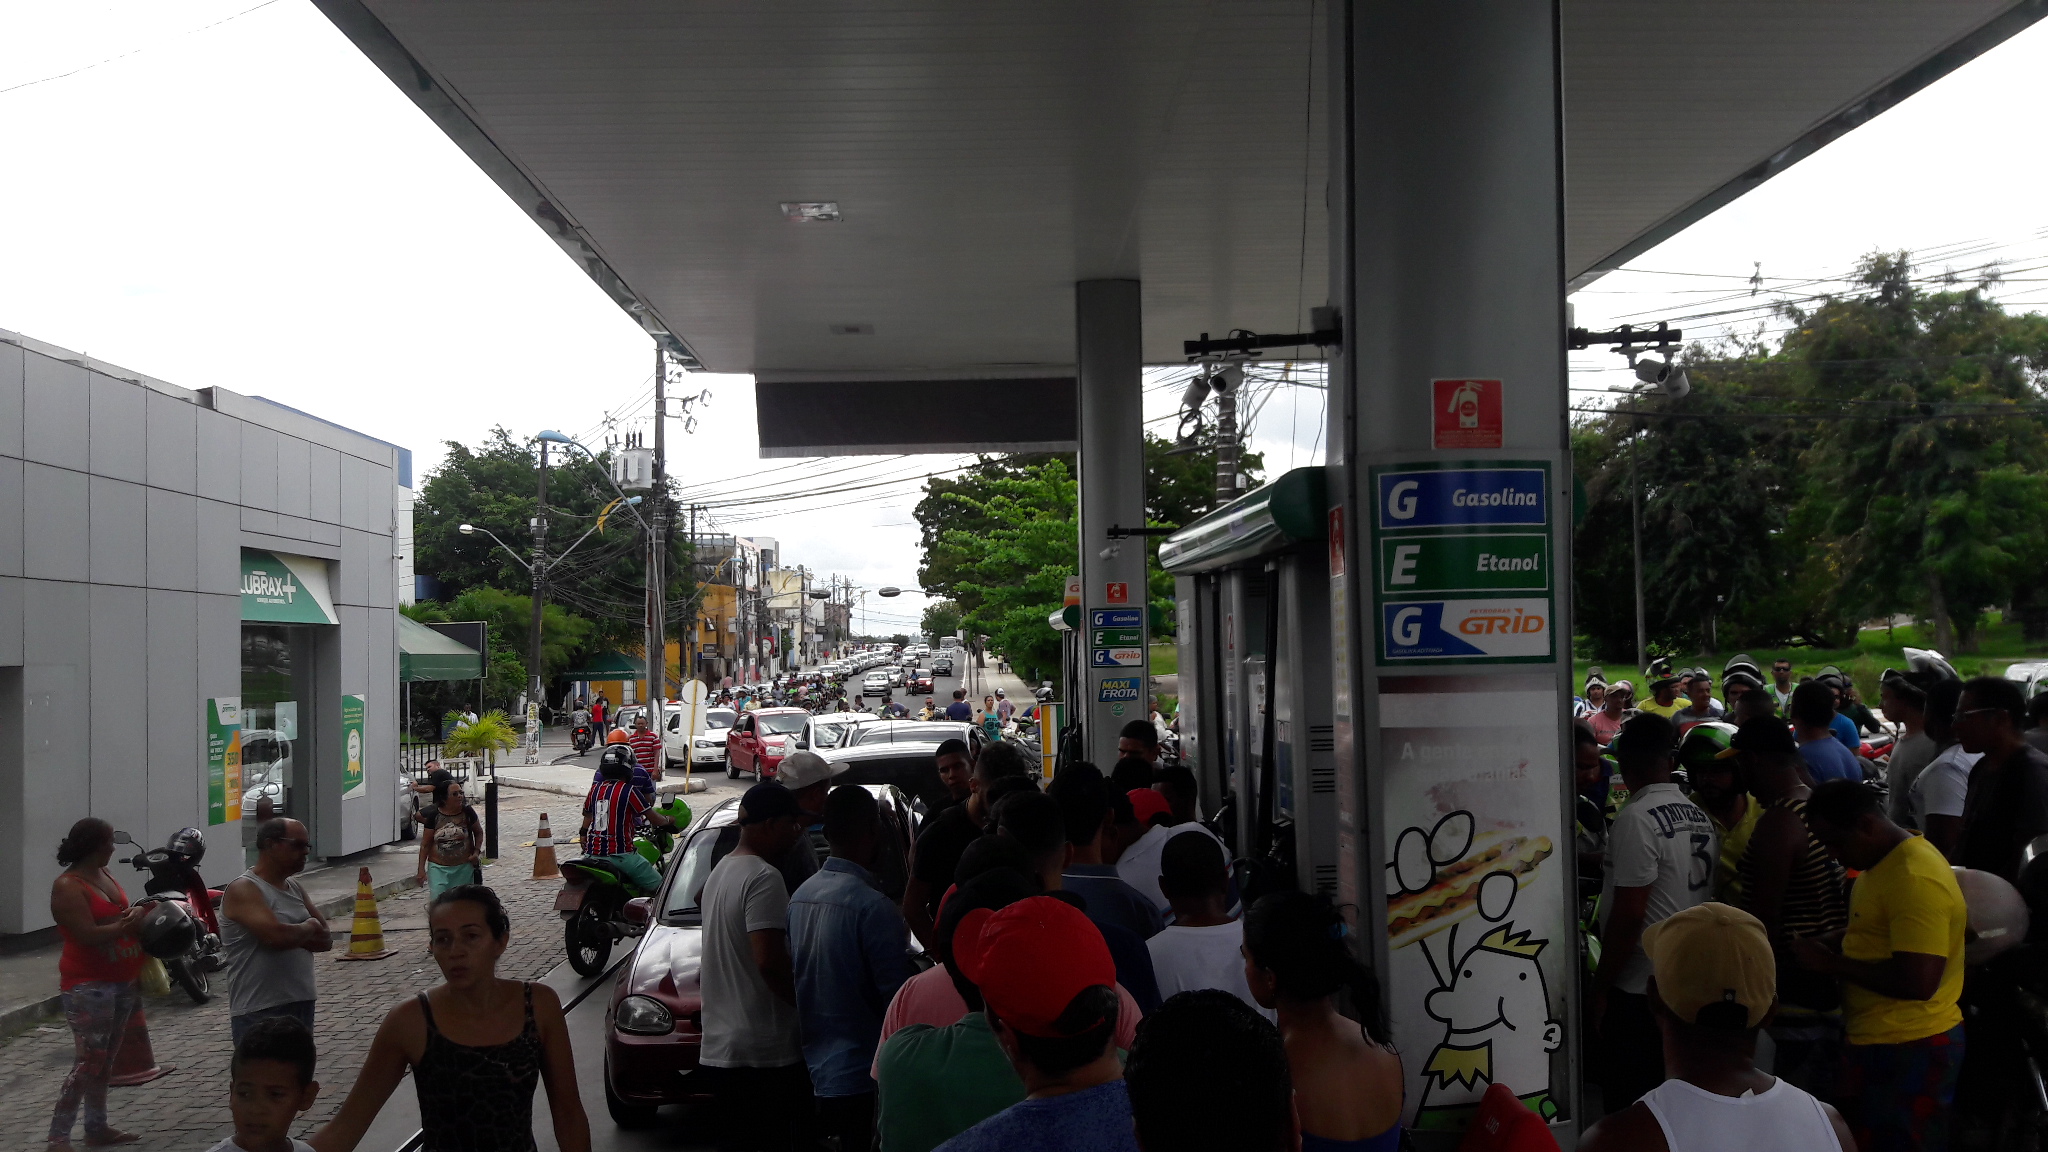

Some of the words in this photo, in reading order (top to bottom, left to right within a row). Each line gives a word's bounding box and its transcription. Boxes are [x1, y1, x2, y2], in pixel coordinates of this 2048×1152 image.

[1388, 480, 1419, 520] G
[1452, 487, 1538, 507] Gasolina
[1390, 544, 1421, 585] E
[1477, 552, 1539, 572] Etanol
[1094, 613, 1104, 625] G
[1392, 606, 1423, 646] G
[1459, 608, 1545, 635] GRID
[1094, 632, 1104, 645] E
[1095, 651, 1105, 662] G
[1102, 680, 1131, 689] MAXI
[1102, 688, 1138, 699] FROTA
[1400, 742, 1415, 760] A
[1687, 833, 1713, 892] 3
